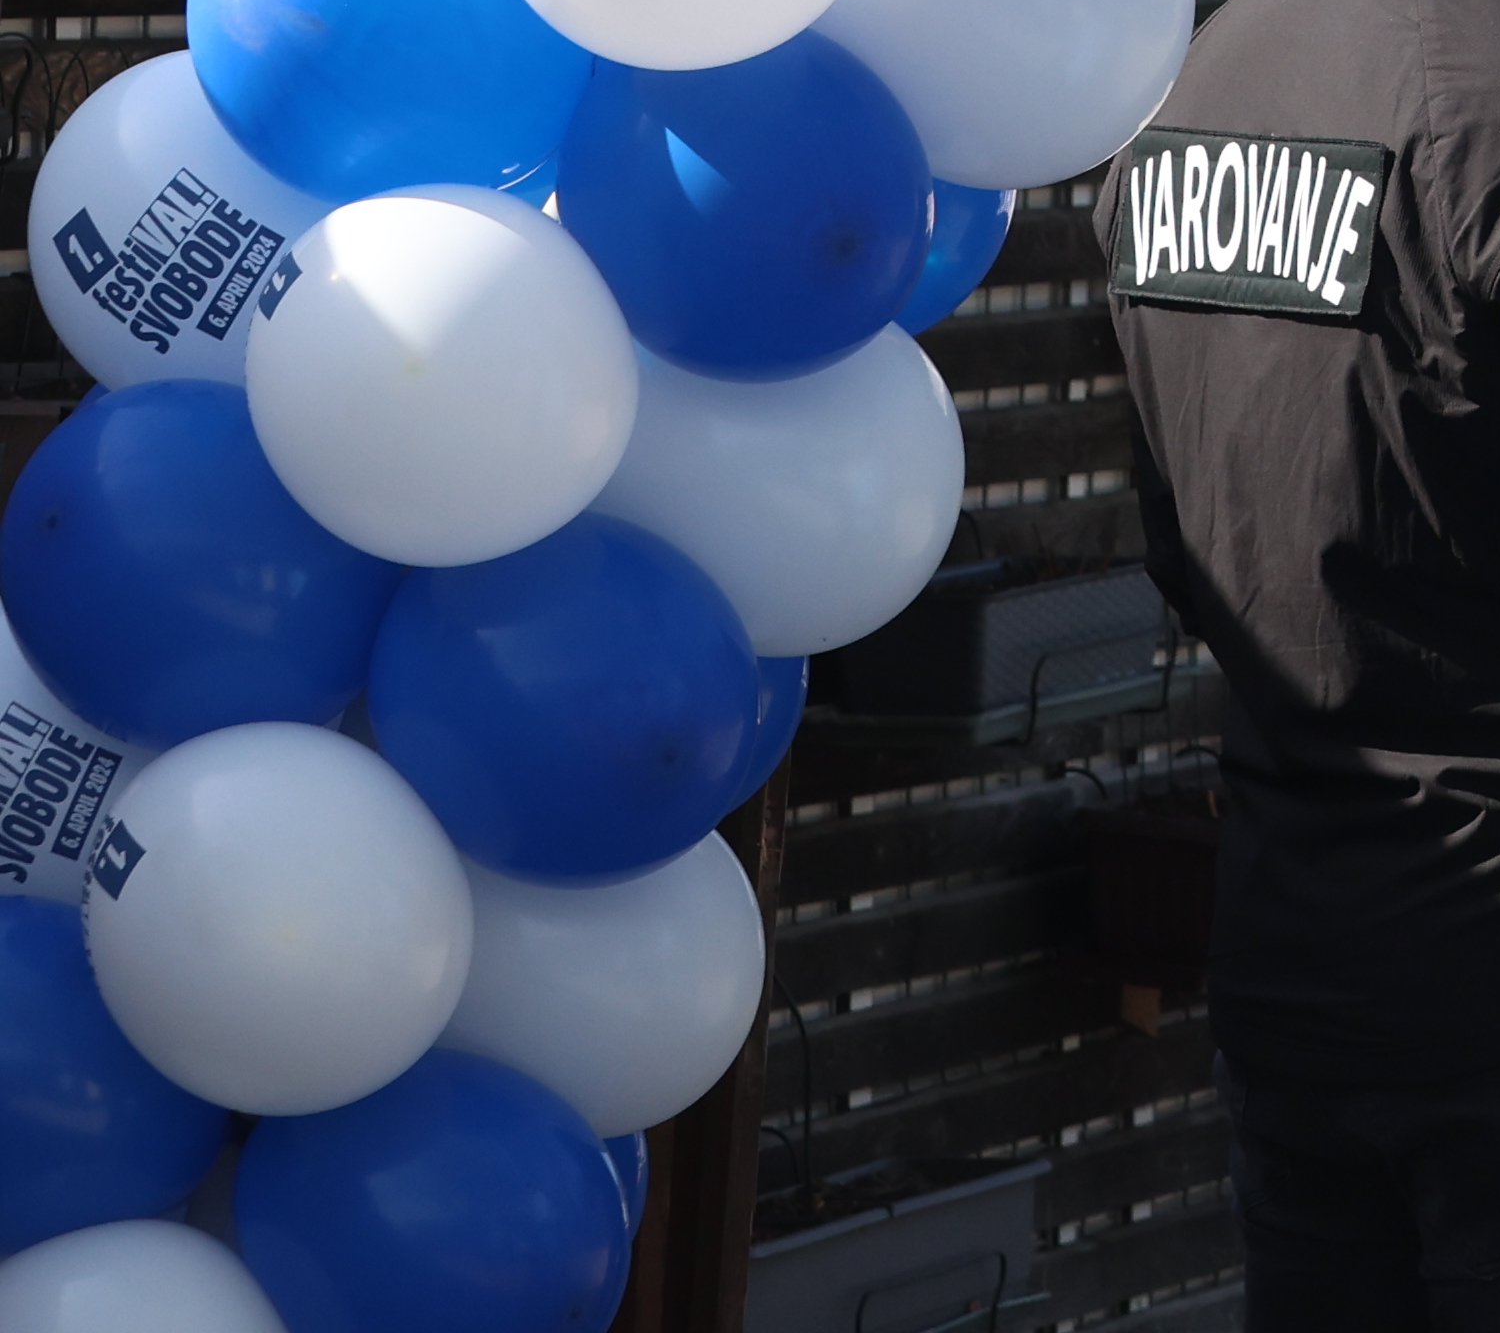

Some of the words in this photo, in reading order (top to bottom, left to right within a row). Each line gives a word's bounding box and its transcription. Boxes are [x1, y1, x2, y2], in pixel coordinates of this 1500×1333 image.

[1130, 141, 1375, 306] VAROVANJE
[241, 235, 278, 275] 2024
[130, 199, 257, 354] SVOBODE
[216, 272, 254, 315] APRIL
[208, 313, 230, 329] 6.
[86, 757, 116, 796] 2024
[67, 794, 99, 835] APRIL
[60, 835, 80, 850] 6.
